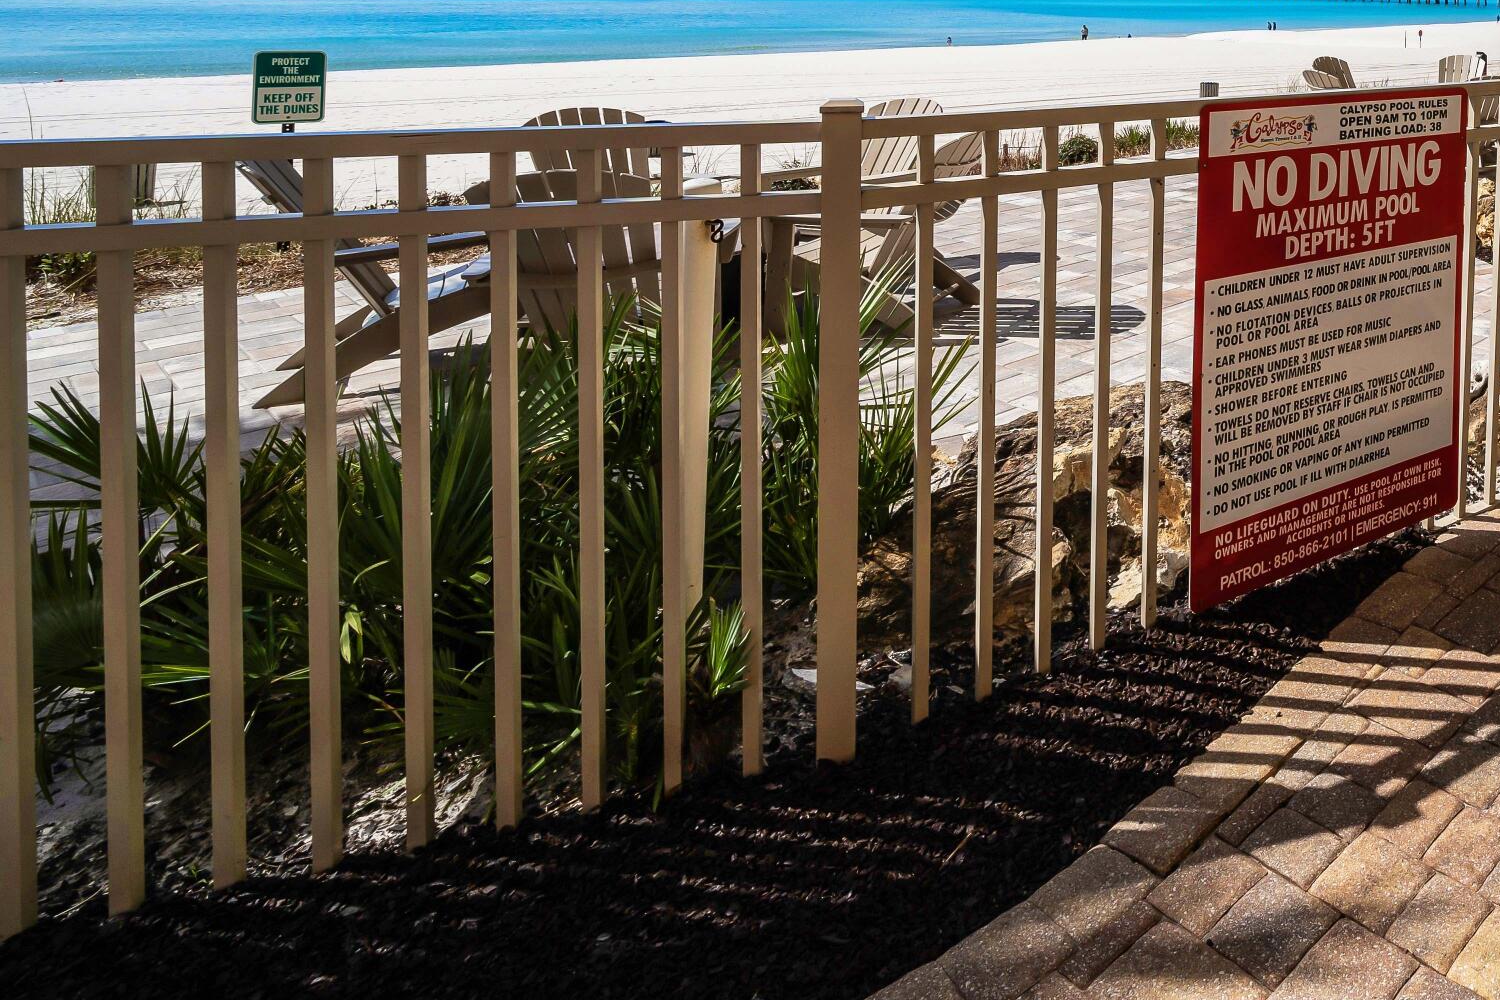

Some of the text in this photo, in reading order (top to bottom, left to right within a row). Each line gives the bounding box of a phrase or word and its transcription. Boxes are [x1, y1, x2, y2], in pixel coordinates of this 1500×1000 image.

[260, 75, 320, 83] ENVIRONMENT
[264, 93, 315, 103] KEEP OFF
[259, 104, 318, 114] THE DUNES
[1340, 99, 1448, 114] CALYPSO POOL RULES
[1340, 110, 1447, 127] OPEN 9AM TO 10PM
[1340, 122, 1441, 140] BATHING LOAD: 38
[1232, 141, 1442, 212] NO DIVING
[1256, 192, 1420, 238] MAXIMUM POOL
[1285, 220, 1396, 259] DEPTH: 5FT
[1217, 260, 1451, 317] NO GLASS, ANIMALS, FOOD OR DRINK IN POOL/POOL AREA
[1218, 242, 1451, 296] CHILDREN UNDER 12 MUST HAVE ADULT SUPERVISION
[1216, 317, 1318, 349] POOL OR POOL AREA
[1217, 325, 1232, 337] NO
[1236, 313, 1290, 333] FLOTATION
[1336, 296, 1361, 310] BALLS
[1365, 293, 1376, 303] OR
[1380, 281, 1431, 300] PROJECTILES
[1434, 279, 1442, 288] IN
[1215, 320, 1441, 385] CHILDREN UNDER 3 MUST WEAR SWIM DIAPERS AND
[1216, 317, 1391, 368] EAR PHONES MUST BE USED FOR MUSIC
[1215, 362, 1321, 398] APPROVED SWIMMERS
[1215, 370, 1347, 415] SHOWER BEFORE ENTERING
[1215, 413, 1252, 433] TOWELS
[1256, 409, 1269, 422] DO
[1272, 402, 1291, 417] NOT
[1294, 392, 1330, 411] RESERVE
[1368, 372, 1398, 389] TOWELS
[1400, 367, 1416, 379] CAN
[1418, 363, 1434, 374] AND
[1214, 370, 1444, 446] WILL BE REMOVED BY STAFF IF CHAIR IS NOT OCCUPIED
[1215, 452, 1229, 465] NO
[1323, 420, 1335, 431] OR
[1338, 410, 1366, 427] ROUGH
[1392, 398, 1398, 410] IS
[1401, 387, 1442, 407] PERMITTED
[1214, 429, 1340, 477] IN THE POOL OR POOL AREA
[1214, 417, 1429, 496] NO SMOKING OR VAPING OF ANY KIND PERMITTED
[1214, 446, 1390, 516] DO NOT USE POOL IF ILL WITH DIARRHEA
[1216, 458, 1442, 548] NO LIFEGUARD ON DUTY. USE POOL AT OWN RISK.
[1215, 468, 1442, 560] OWNERS AND MANAGEMENT ARE NOT RESPONSIBLE FOR
[1286, 500, 1384, 544] ACCIDENTS OR INJURIES.
[1220, 494, 1438, 591] PATROL: 850-866-2101 EMERGENCY: 911
